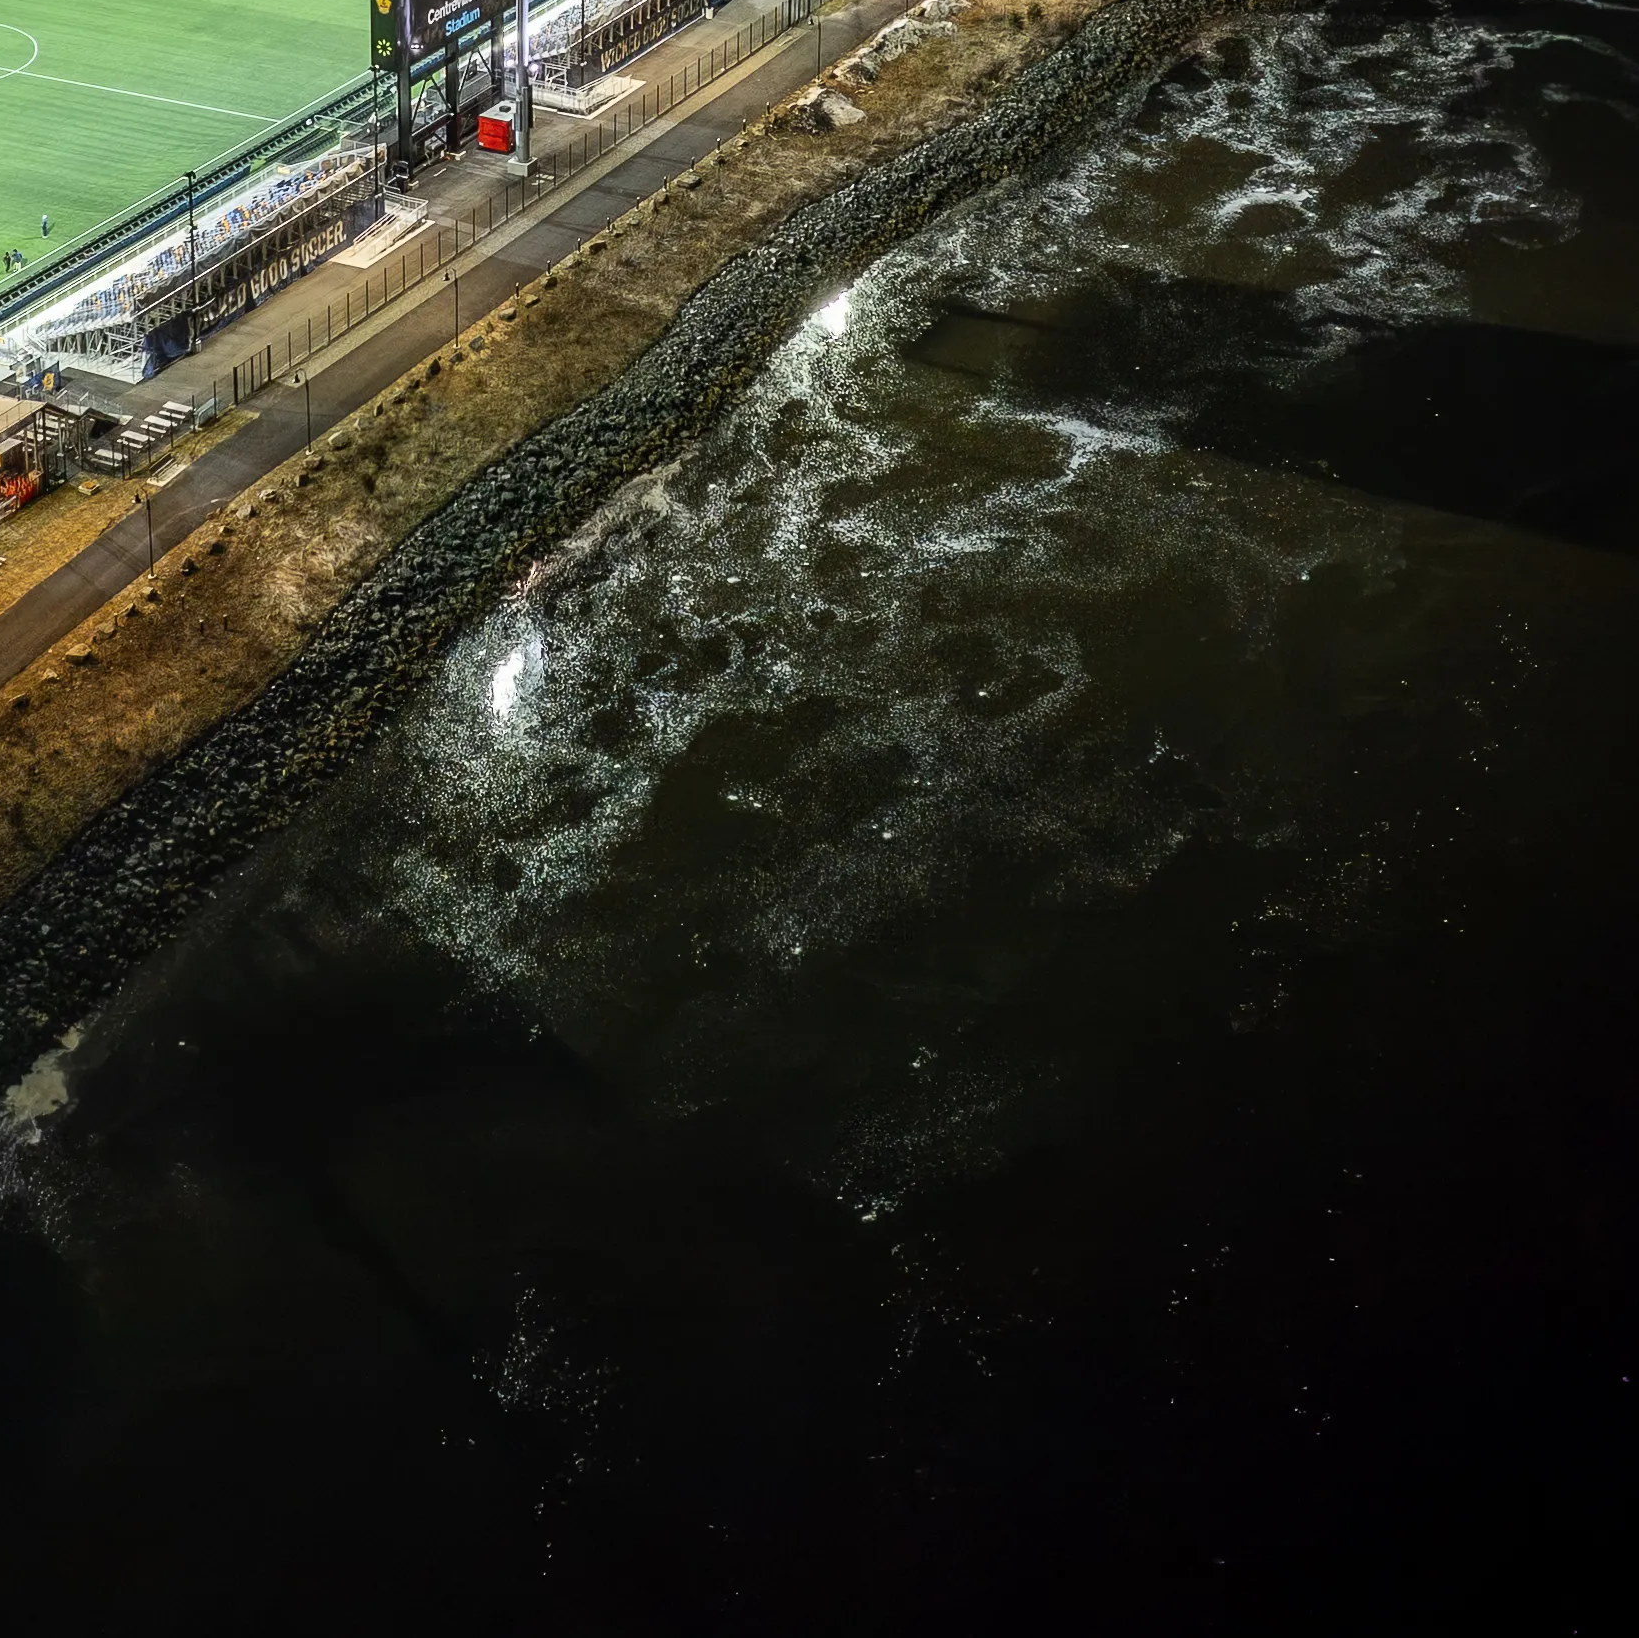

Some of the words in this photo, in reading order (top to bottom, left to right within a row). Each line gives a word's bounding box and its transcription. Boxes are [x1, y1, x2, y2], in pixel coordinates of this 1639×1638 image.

[445, 7, 481, 37] Stadium
[600, 29, 641, 73] WICKED
[250, 258, 289, 299] GOOD
